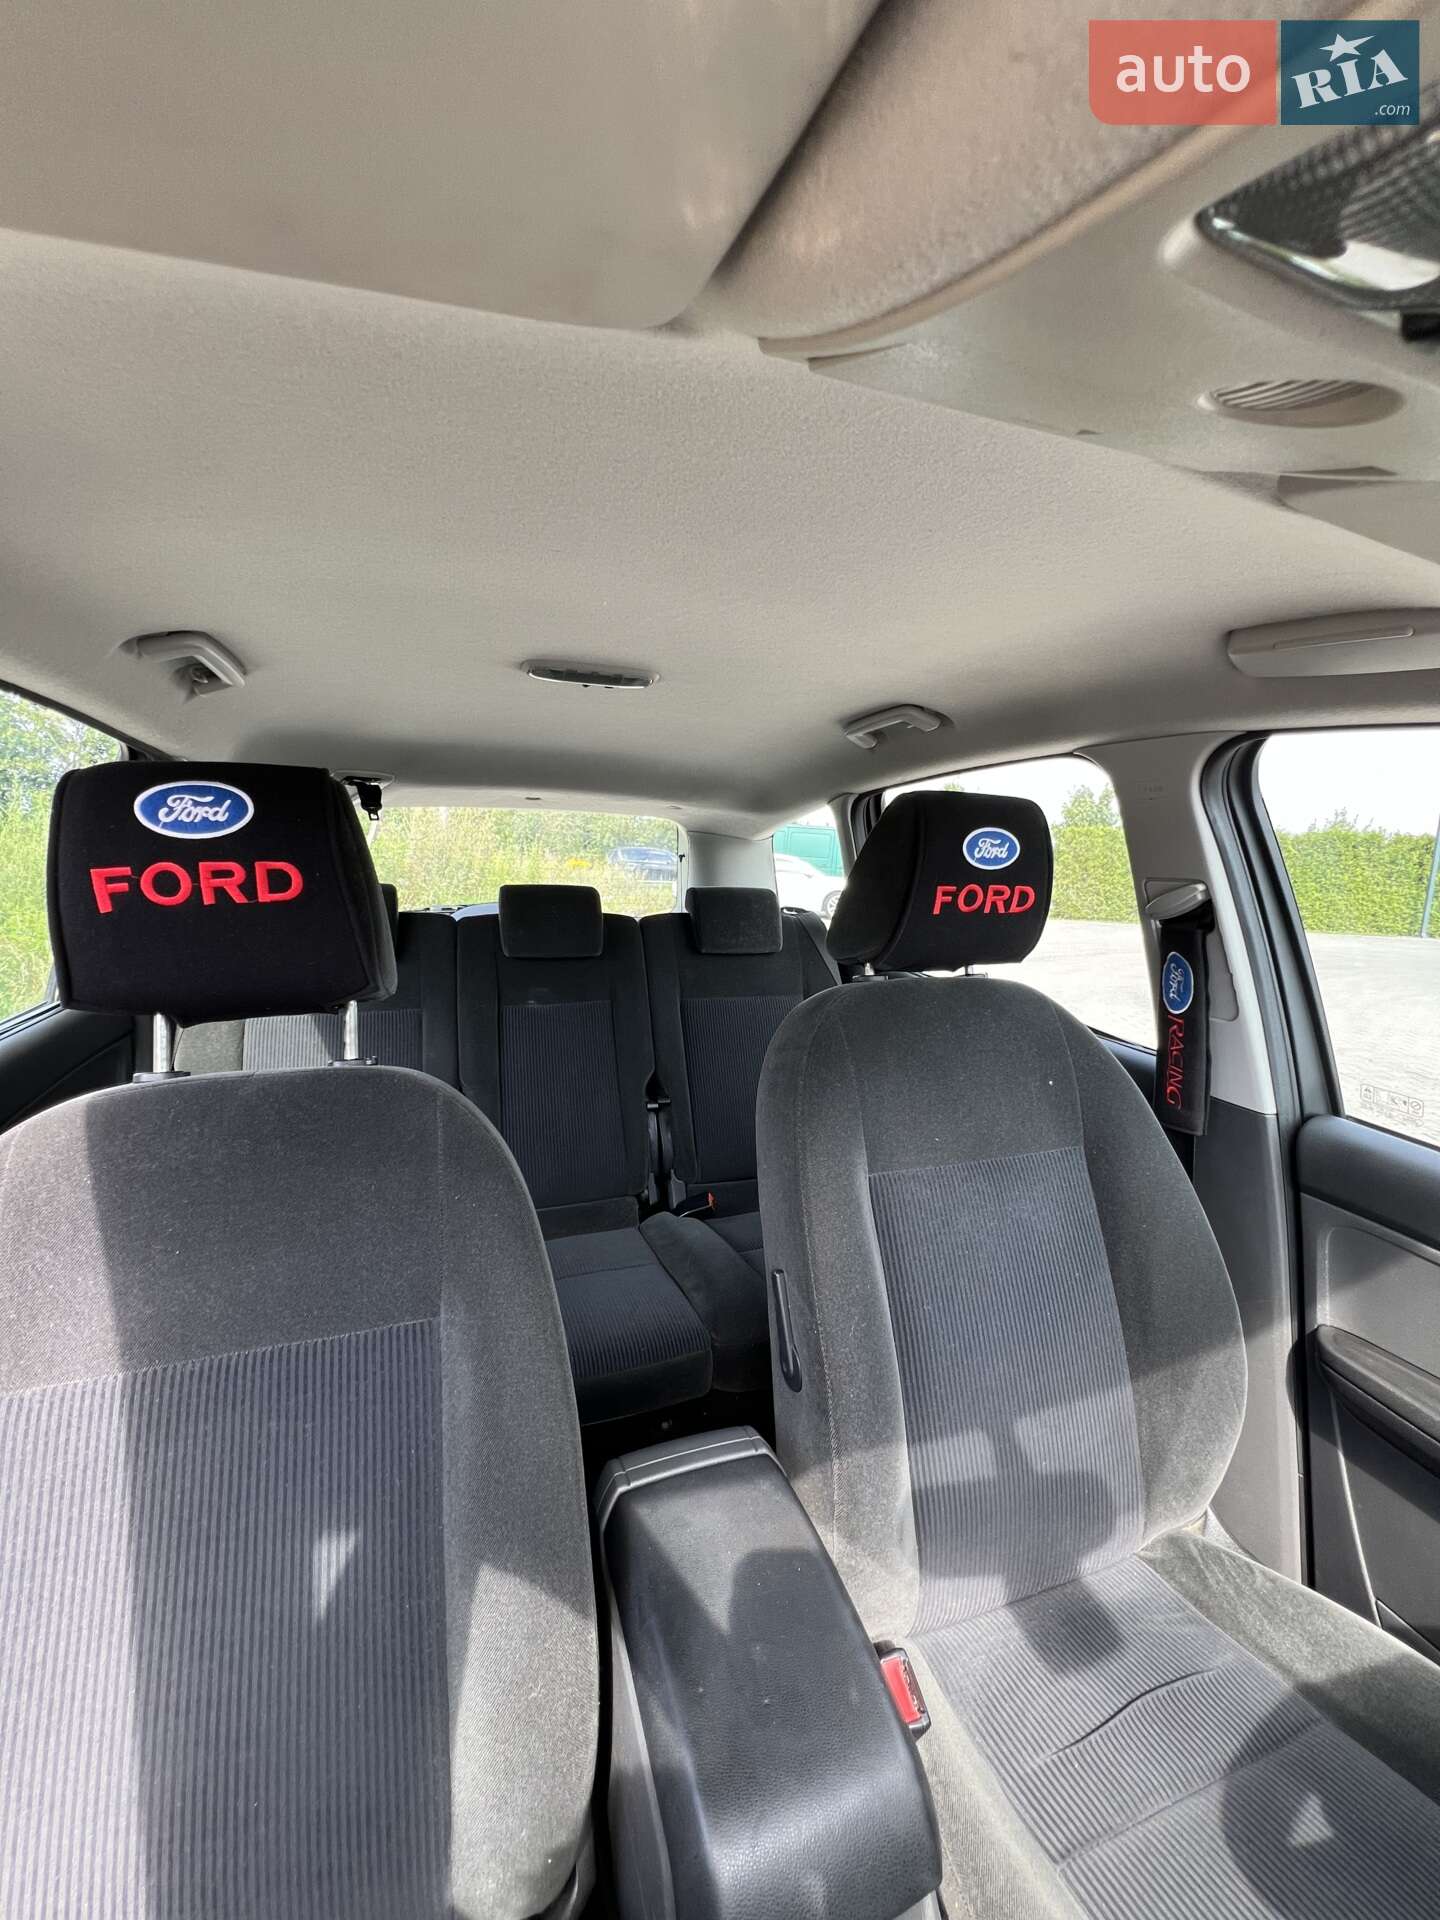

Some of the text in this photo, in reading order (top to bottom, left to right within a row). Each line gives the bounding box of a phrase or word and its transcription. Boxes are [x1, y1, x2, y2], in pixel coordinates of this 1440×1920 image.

[158, 794, 231, 822] Ford
[974, 838, 1010, 859] Ford
[90, 861, 304, 914] FORD
[932, 884, 1035, 915] FORD
[1169, 963, 1184, 1002] Ford
[1167, 1014, 1185, 1111] RACING
